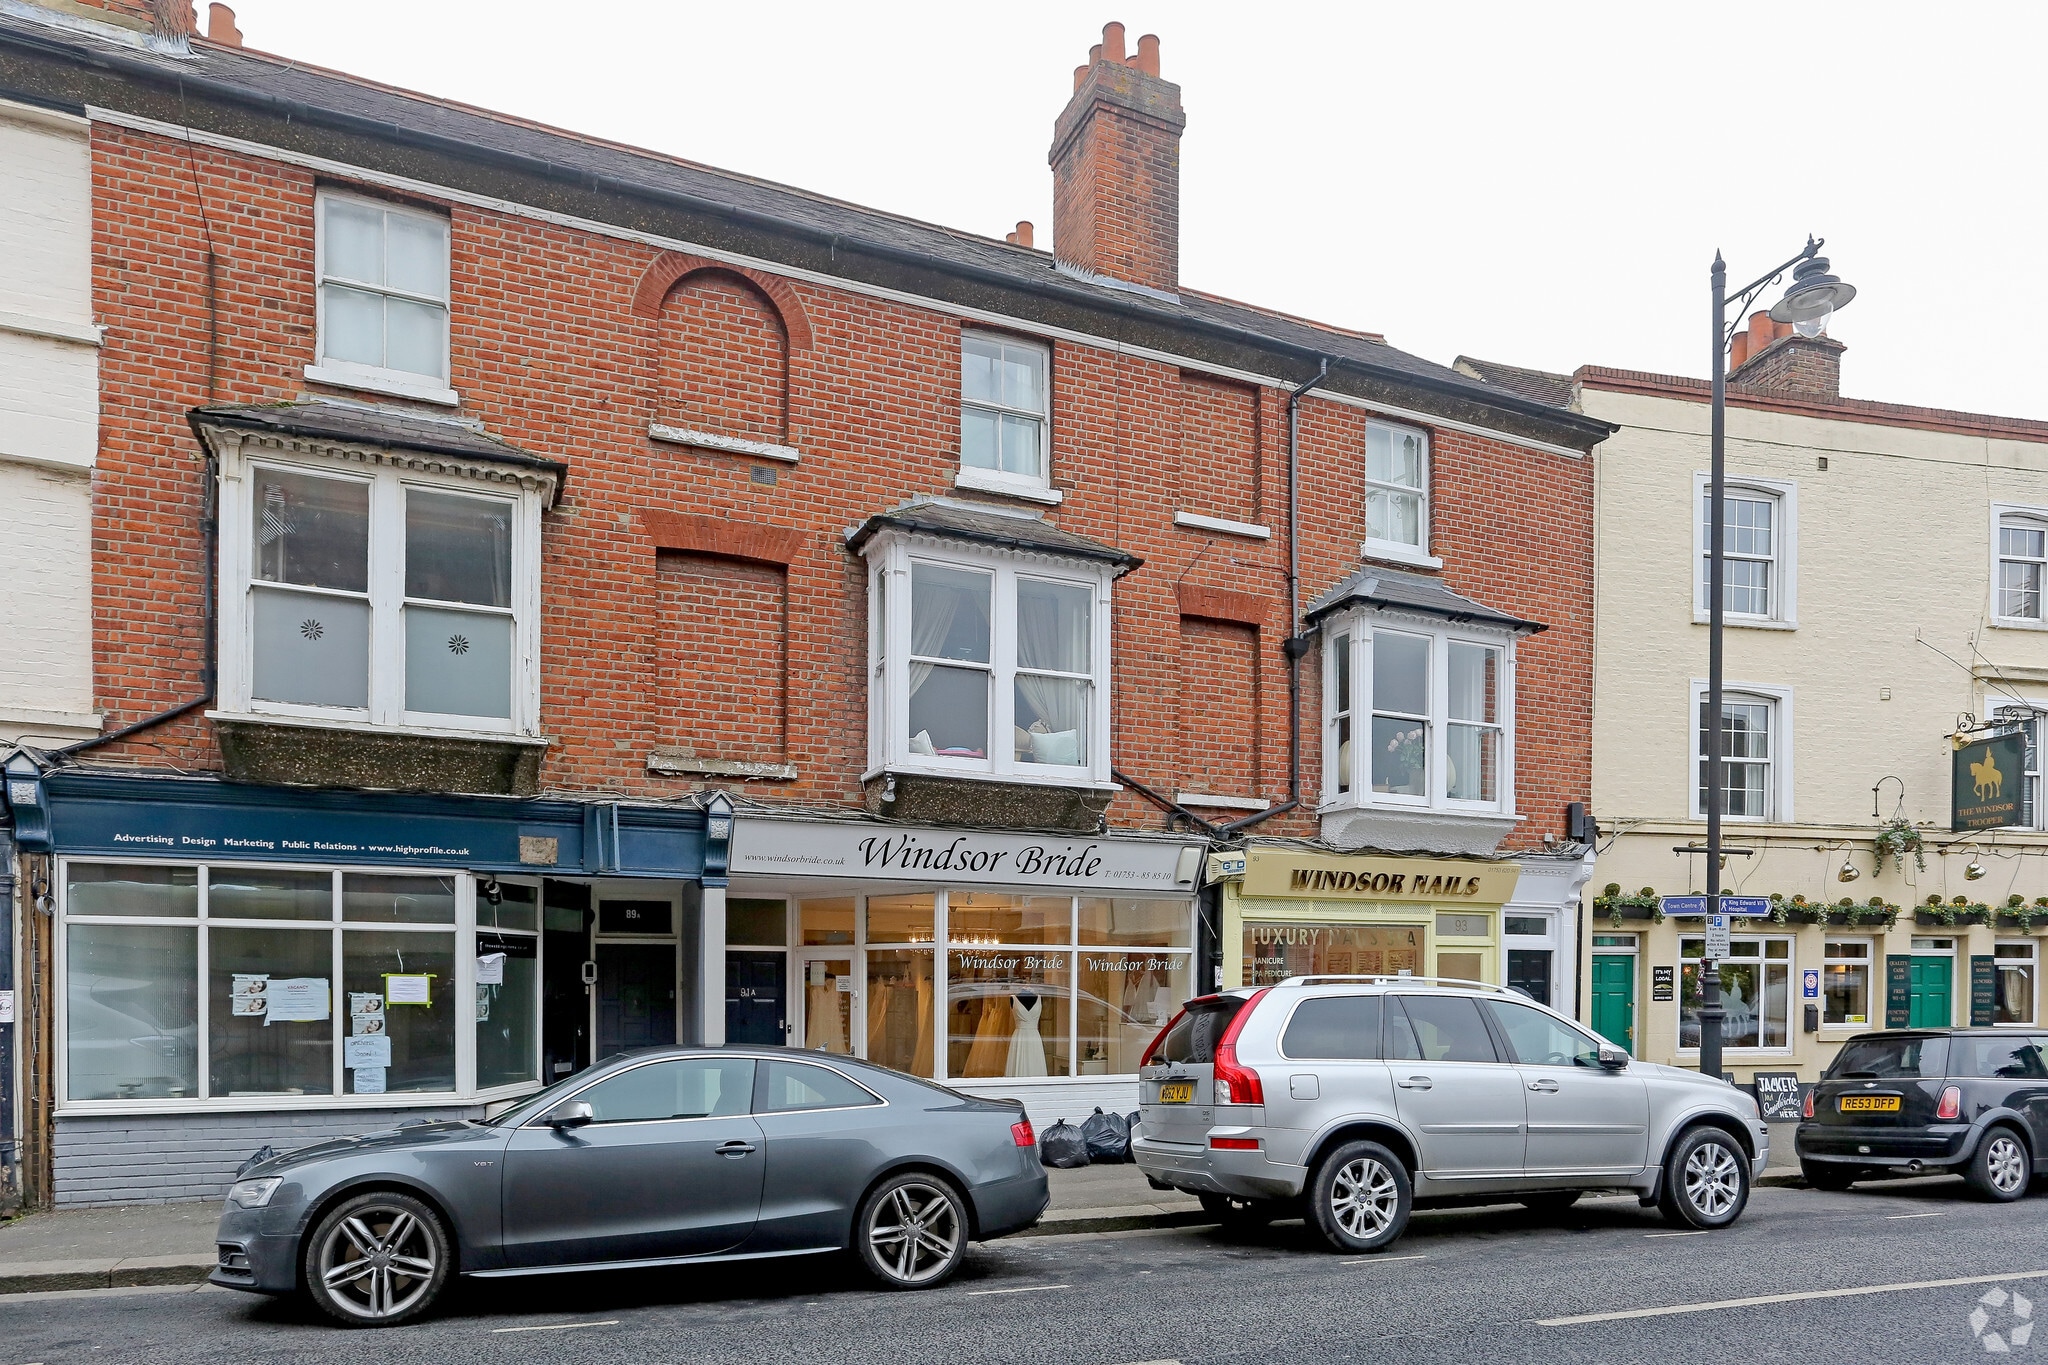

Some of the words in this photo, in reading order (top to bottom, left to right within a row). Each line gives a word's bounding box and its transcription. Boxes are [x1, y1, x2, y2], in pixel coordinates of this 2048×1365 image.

[1958, 808, 1974, 817] THE
[1975, 802, 2014, 814] WINDSOR
[1967, 816, 2004, 827] TROOPER
[114, 833, 174, 846] Advertising
[182, 836, 216, 847] Design
[224, 837, 275, 850] Marketing
[282, 840, 310, 849] Public
[314, 841, 357, 851] Relations
[368, 844, 470, 856] www.highprofile.co.uk
[744, 853, 846, 866] www.windsorbride.co.uk
[858, 833, 1008, 872] Windsor
[1015, 844, 1102, 877] Bride
[1113, 871, 1136, 879] 01753
[1290, 869, 1406, 894] WINDSOR
[1410, 874, 1481, 896] NAILS
[1455, 919, 1468, 931] 93
[1251, 928, 1320, 946] LUXURY
[1328, 929, 1378, 946] NAIS
[956, 953, 1020, 969] Windsor
[1024, 955, 1063, 969] Bride
[1086, 957, 1144, 971] Windsor
[1147, 956, 1184, 971] Bride
[1758, 1077, 1799, 1092] JACKETS
[1763, 1092, 1801, 1117] Sandwiches
[1845, 1098, 1872, 1109] RE53
[1874, 1098, 1895, 1109] DFP
[1779, 1110, 1799, 1118] HERE
